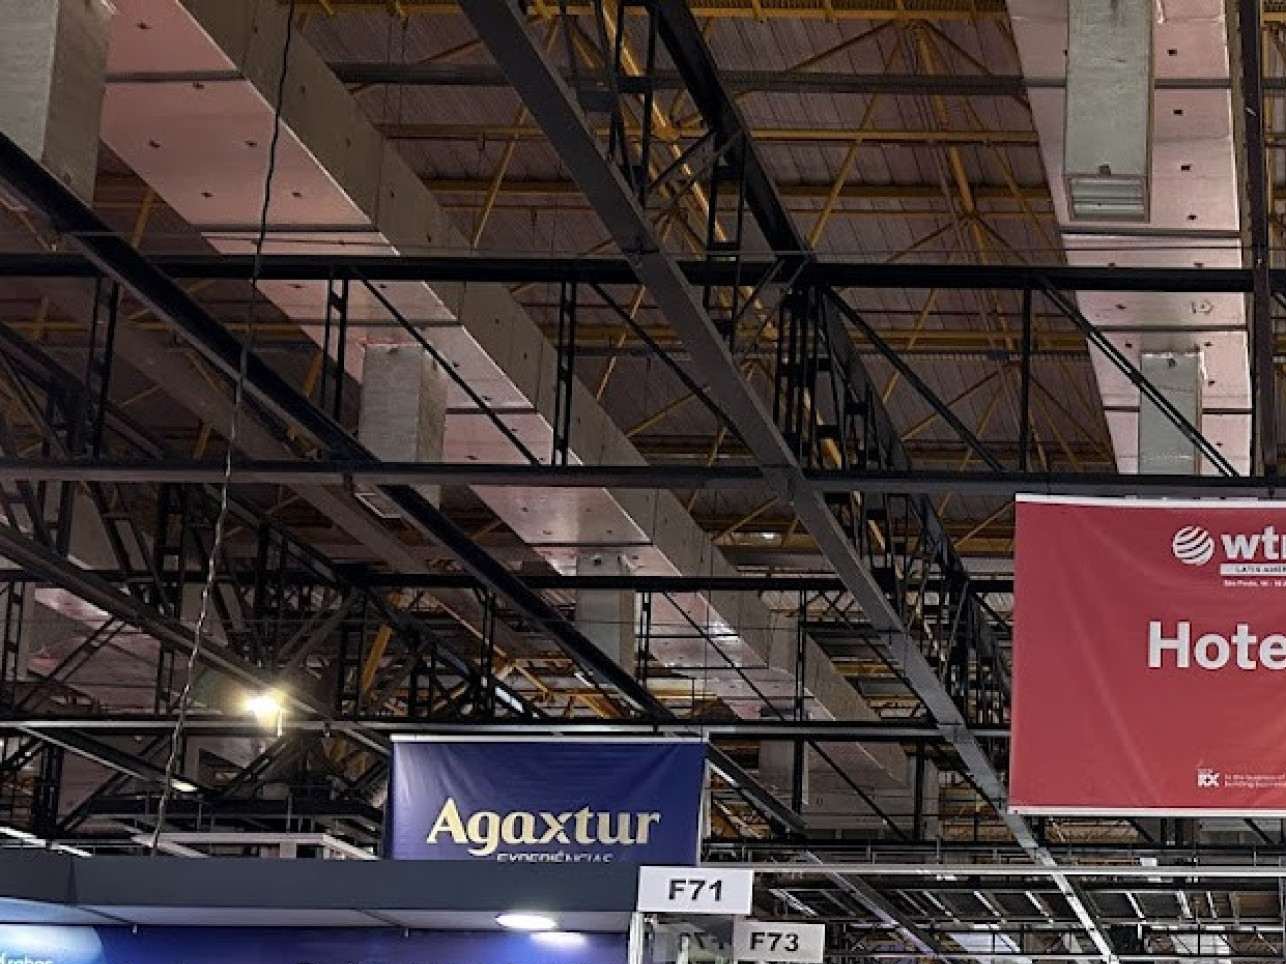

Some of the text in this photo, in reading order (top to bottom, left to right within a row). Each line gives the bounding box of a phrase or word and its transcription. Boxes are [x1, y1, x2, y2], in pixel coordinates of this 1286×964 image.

[426, 797, 662, 857] Agaxtur
[668, 879, 723, 901] F71
[750, 931, 799, 952] F73
